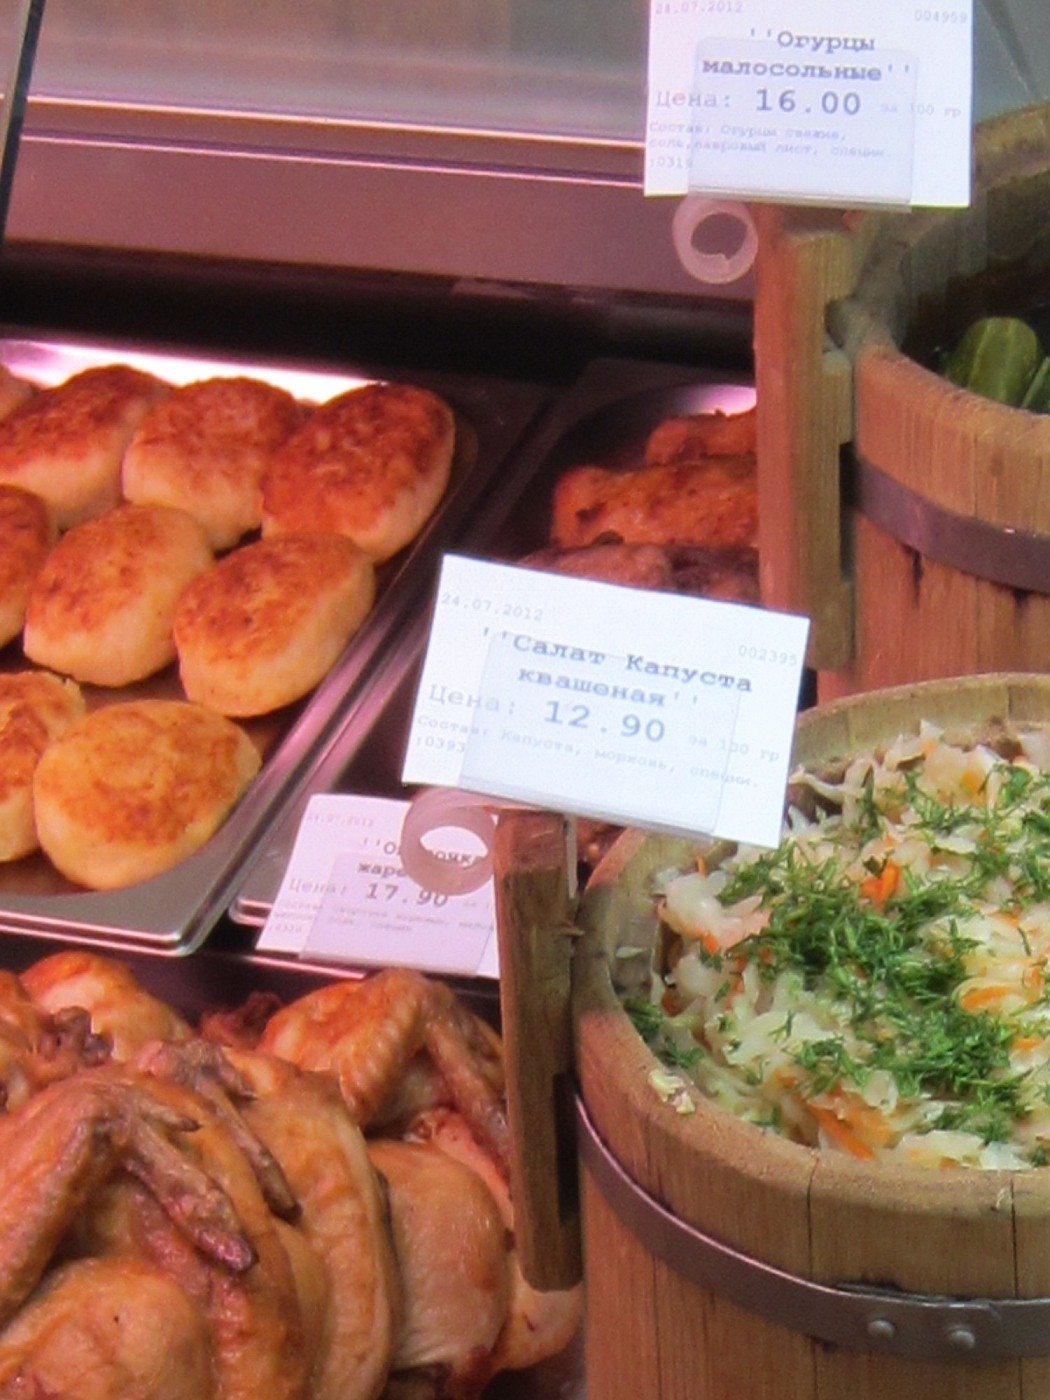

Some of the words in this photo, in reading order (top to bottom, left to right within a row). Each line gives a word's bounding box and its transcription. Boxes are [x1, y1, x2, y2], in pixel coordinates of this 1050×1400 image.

[655, 89, 730, 108] Цена:
[755, 87, 861, 115] 16.00
[440, 591, 543, 622] 24.07.2012
[737, 643, 797, 667] 002395
[625, 653, 751, 692] Капуста
[428, 683, 515, 715] Цена:
[544, 700, 665, 742] 12.90
[759, 748, 780, 763] гр
[365, 881, 450, 908] 17.90
